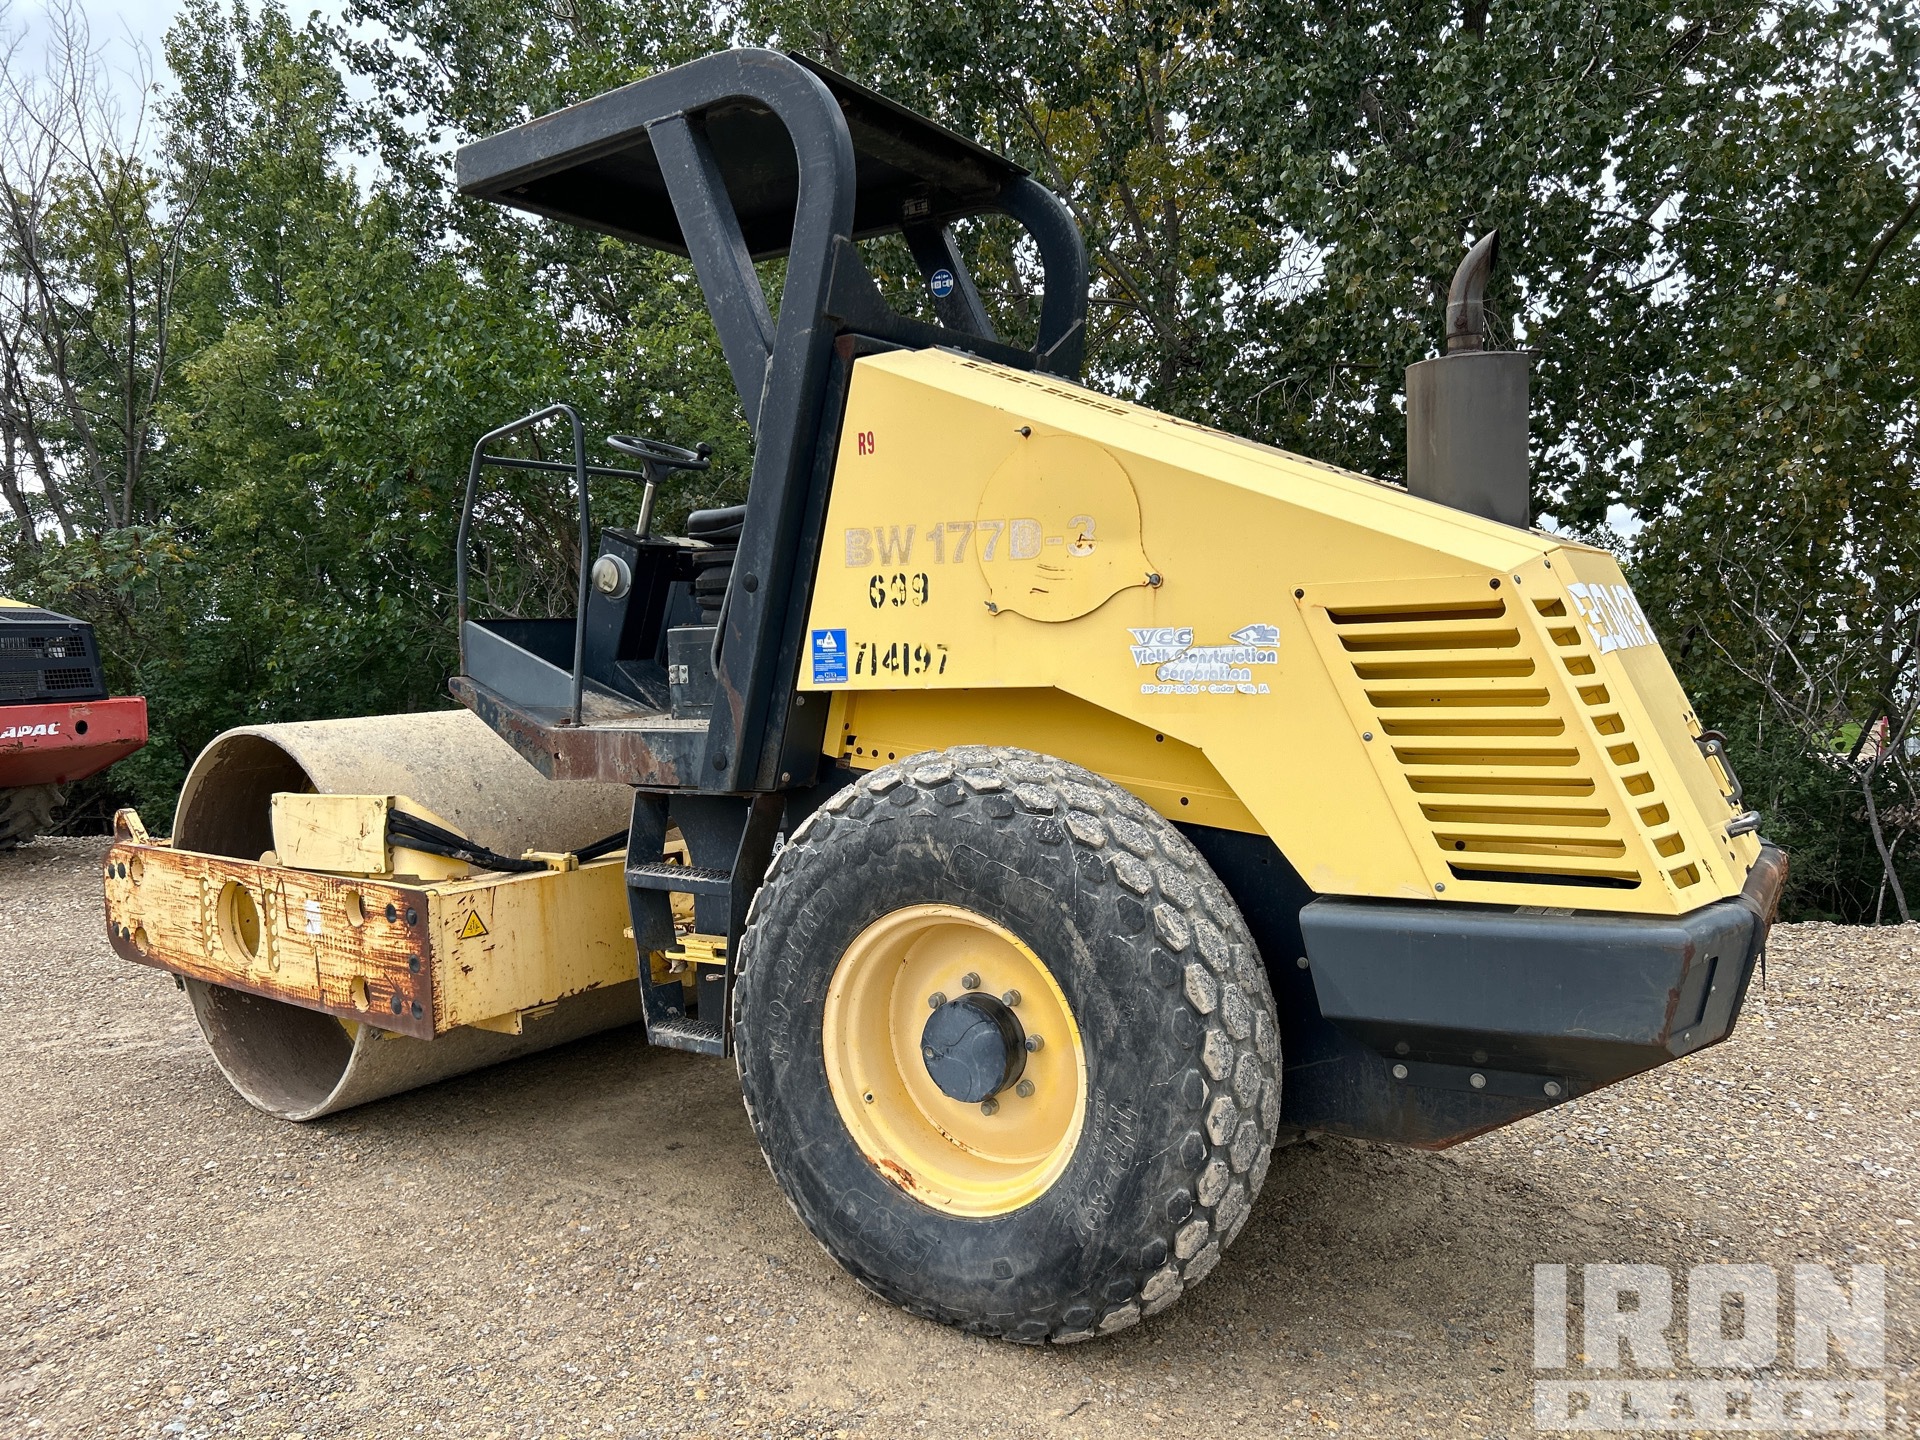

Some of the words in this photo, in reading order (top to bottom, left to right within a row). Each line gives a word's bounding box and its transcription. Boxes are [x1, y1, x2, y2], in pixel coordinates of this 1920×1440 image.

[858, 431, 875, 455] R9
[845, 525, 916, 568] BW
[926, 515, 1098, 564] 177D-3
[1130, 628, 1193, 646] VCC
[855, 642, 948, 677] 714197
[1133, 649, 1171, 664] Vieth
[1176, 647, 1277, 664] Construction
[1157, 666, 1251, 682] Corporation
[1209, 684, 1235, 694] Cedar
[1238, 684, 1257, 694] alls,
[1259, 684, 1270, 693] IA
